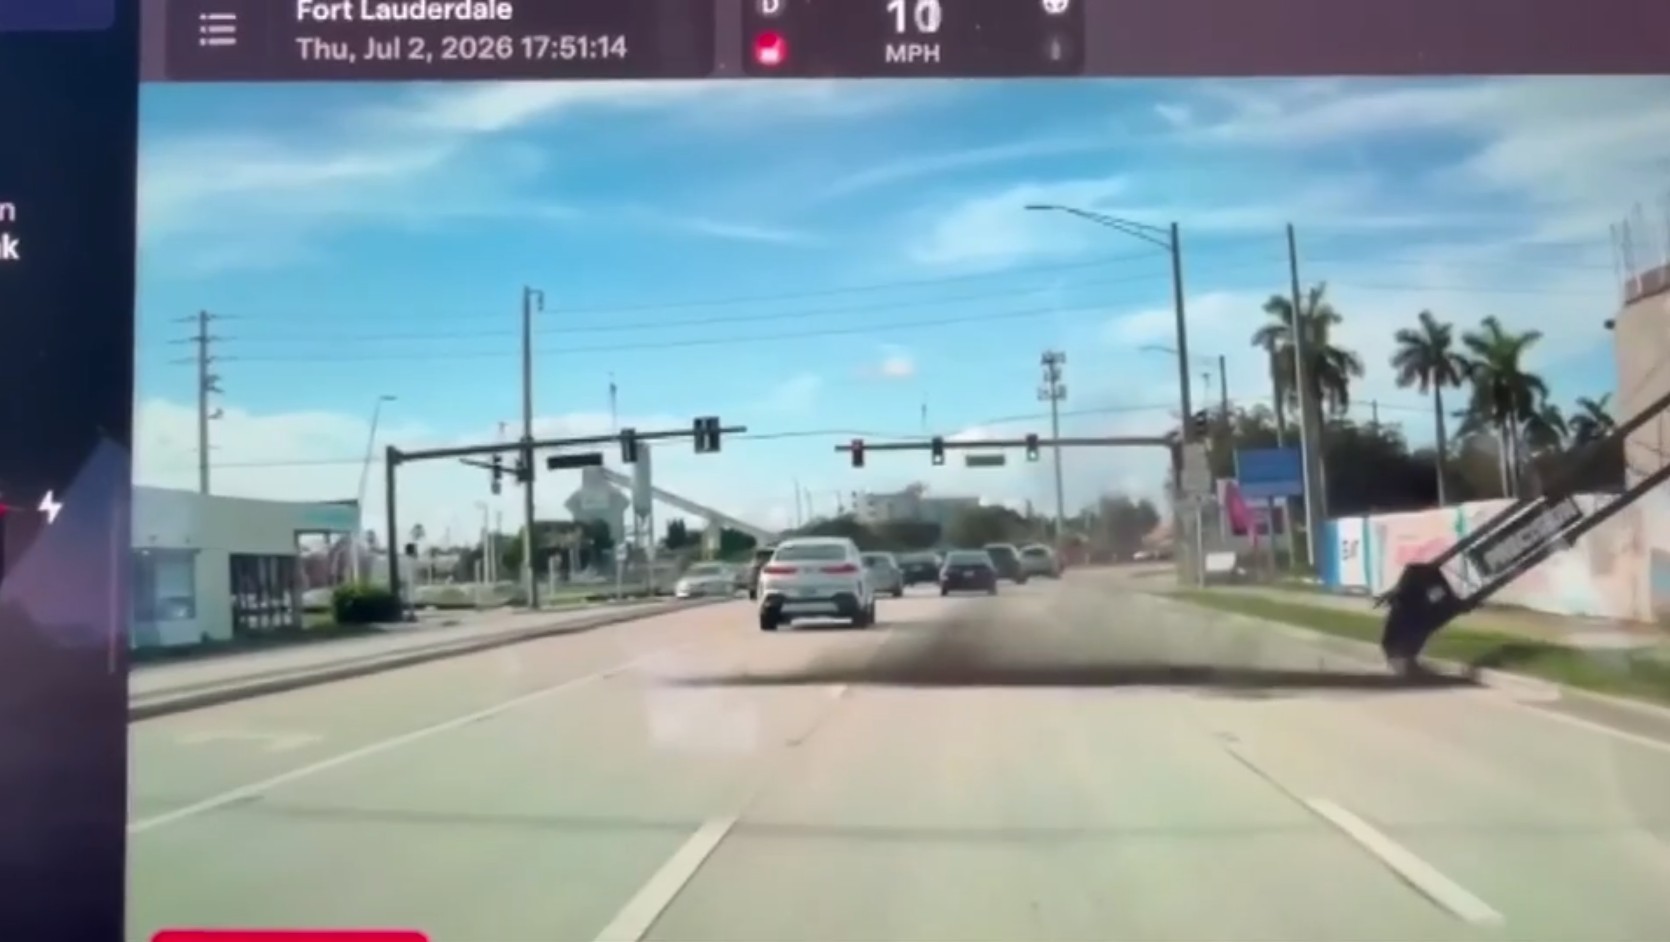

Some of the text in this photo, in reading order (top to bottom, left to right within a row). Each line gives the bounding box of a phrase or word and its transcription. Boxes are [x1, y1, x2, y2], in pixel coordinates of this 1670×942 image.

[296, 0, 513, 21] Fort Lauderdale
[295, 36, 627, 63] Thu, Jul 2, 2026 17:51:14
[885, 43, 940, 63] MPH
[0, 232, 20, 260] k
